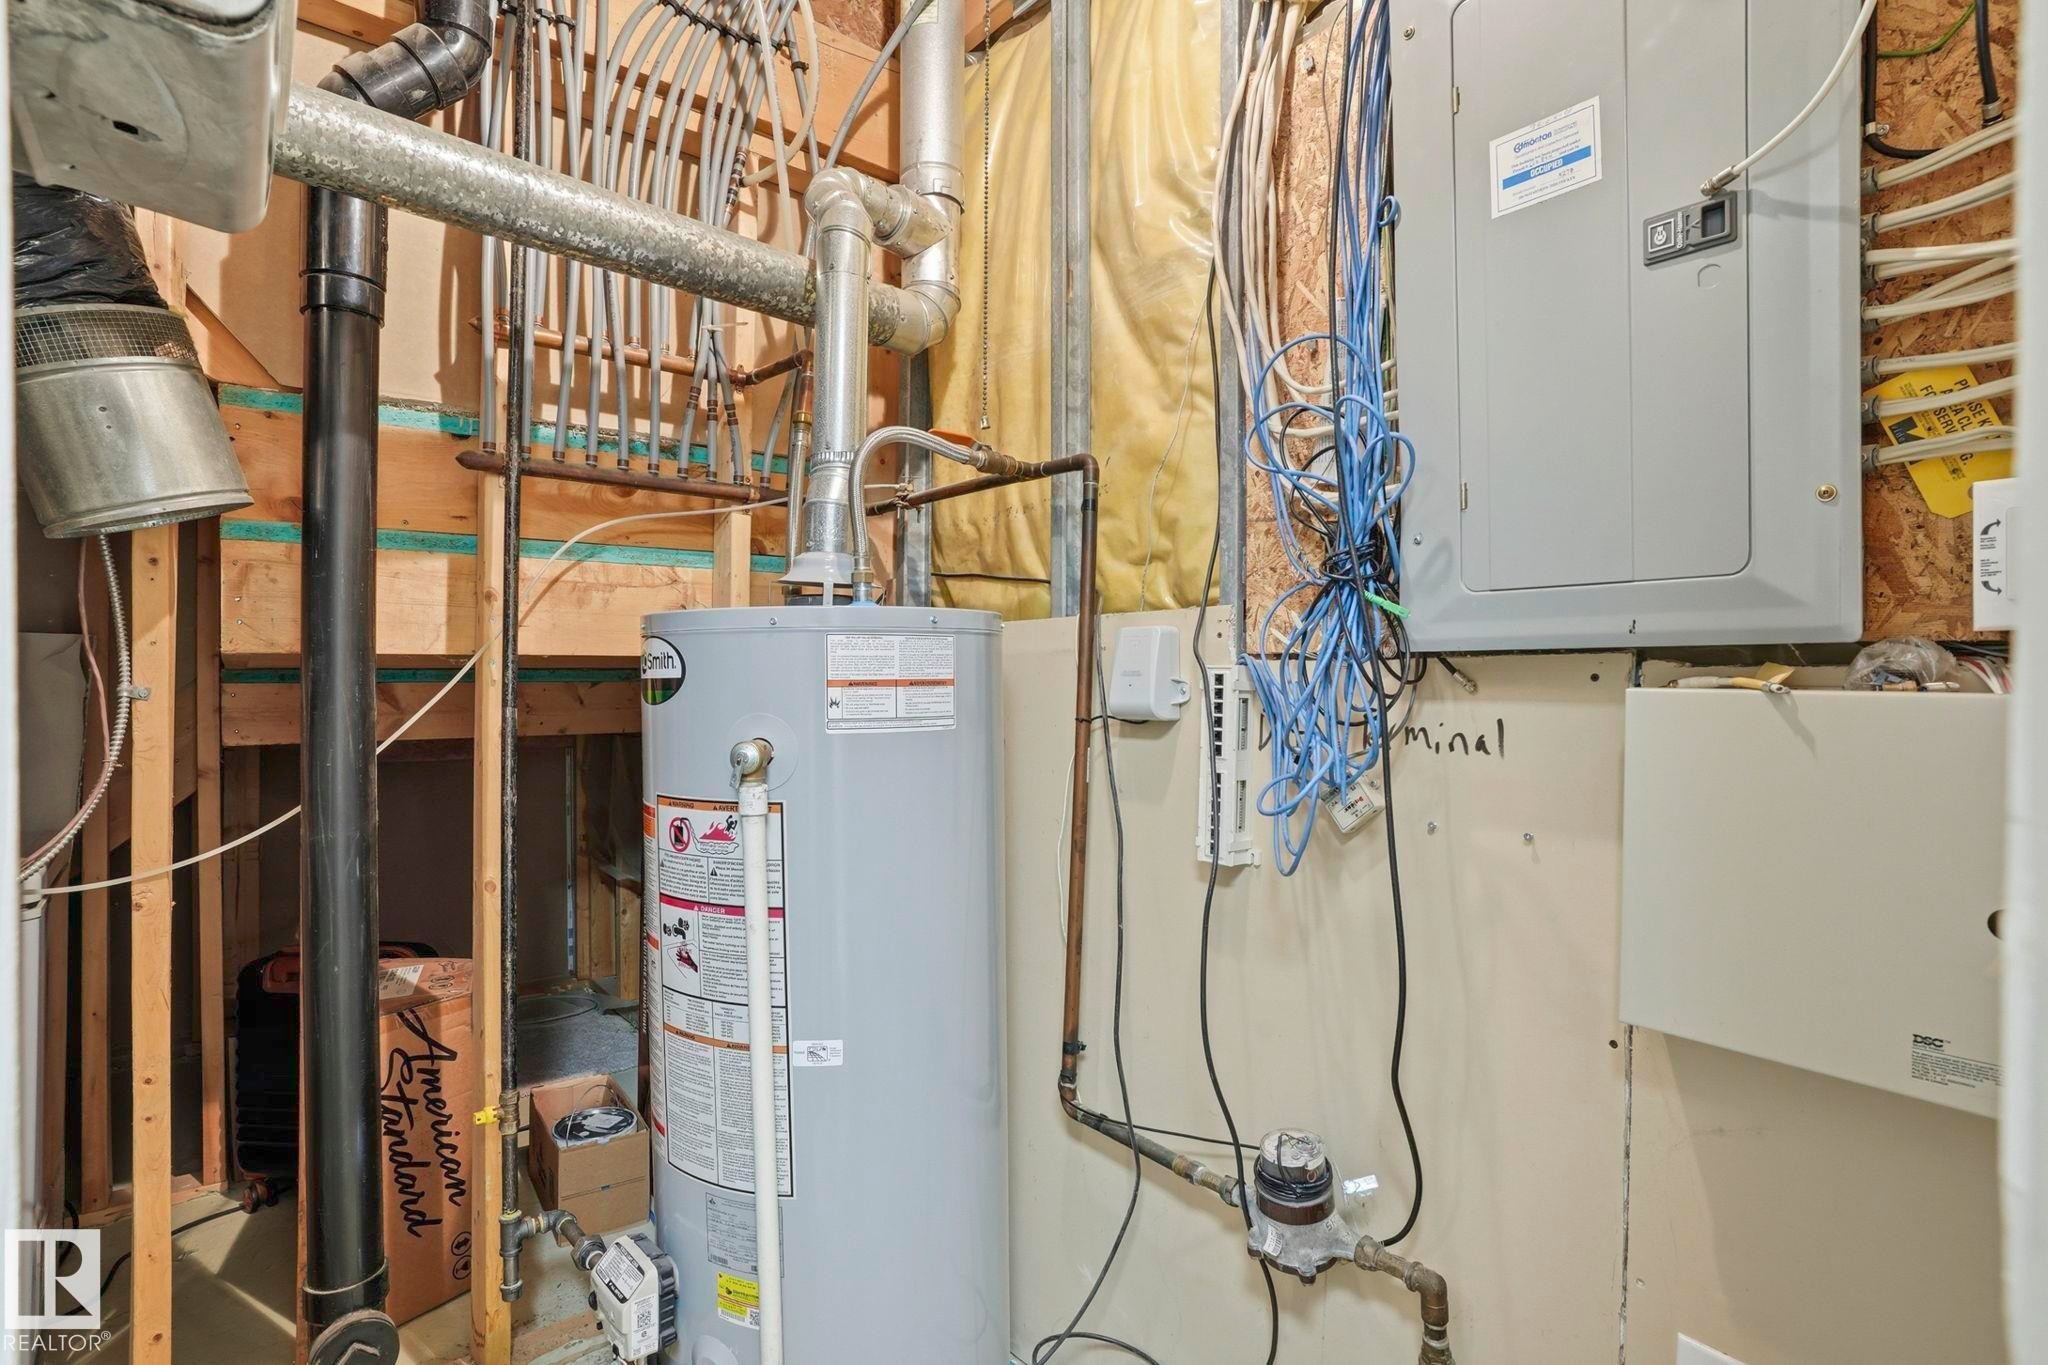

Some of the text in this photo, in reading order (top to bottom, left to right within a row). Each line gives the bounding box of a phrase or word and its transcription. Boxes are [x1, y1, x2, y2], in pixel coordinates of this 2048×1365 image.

[1513, 131, 1553, 154] Edmonton
[1529, 158, 1564, 178] OCCUPIED
[700, 905, 726, 915] DANGER
[396, 1007, 467, 1207] American
[381, 1047, 443, 1238] Standard
